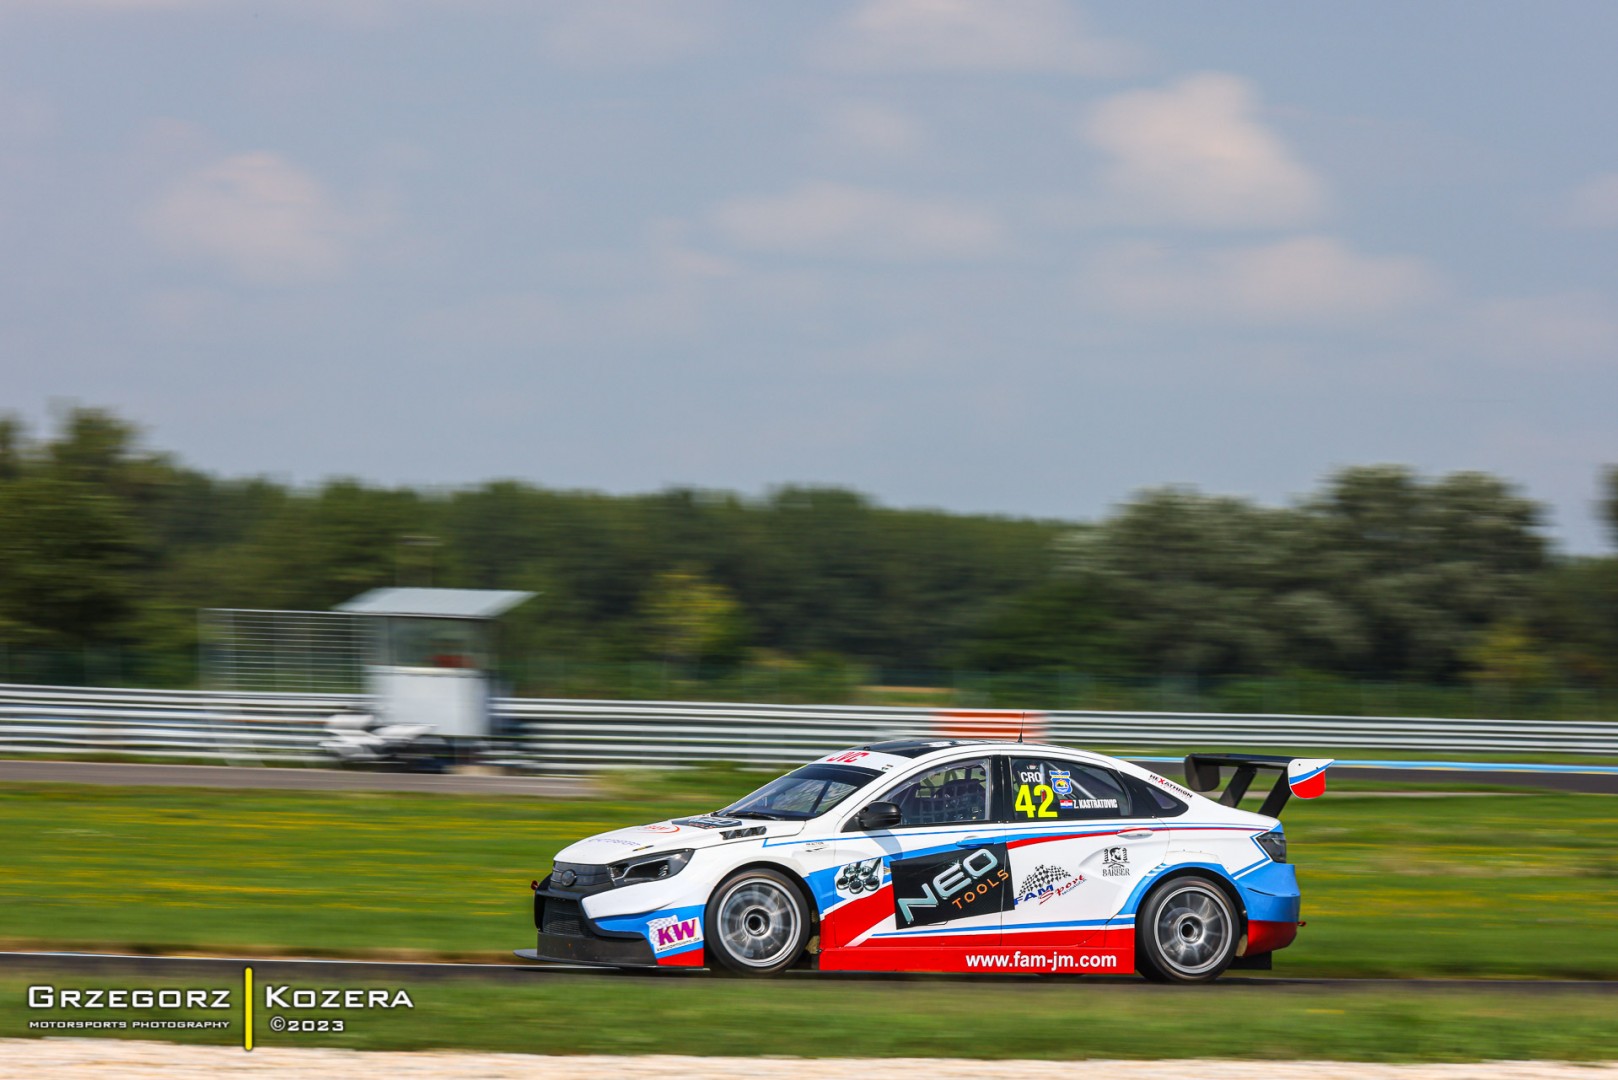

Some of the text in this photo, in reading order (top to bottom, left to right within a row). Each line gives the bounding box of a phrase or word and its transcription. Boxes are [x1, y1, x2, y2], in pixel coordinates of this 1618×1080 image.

[1020, 772, 1042, 783] CRO
[1015, 784, 1058, 818] 42
[898, 848, 998, 924] NEO
[1102, 868, 1130, 877] BARBER
[952, 869, 1009, 909] TOOLS
[1014, 874, 1085, 906] FAM Sport
[657, 919, 696, 947] KW
[965, 951, 1117, 971] www.fam-jm.com
